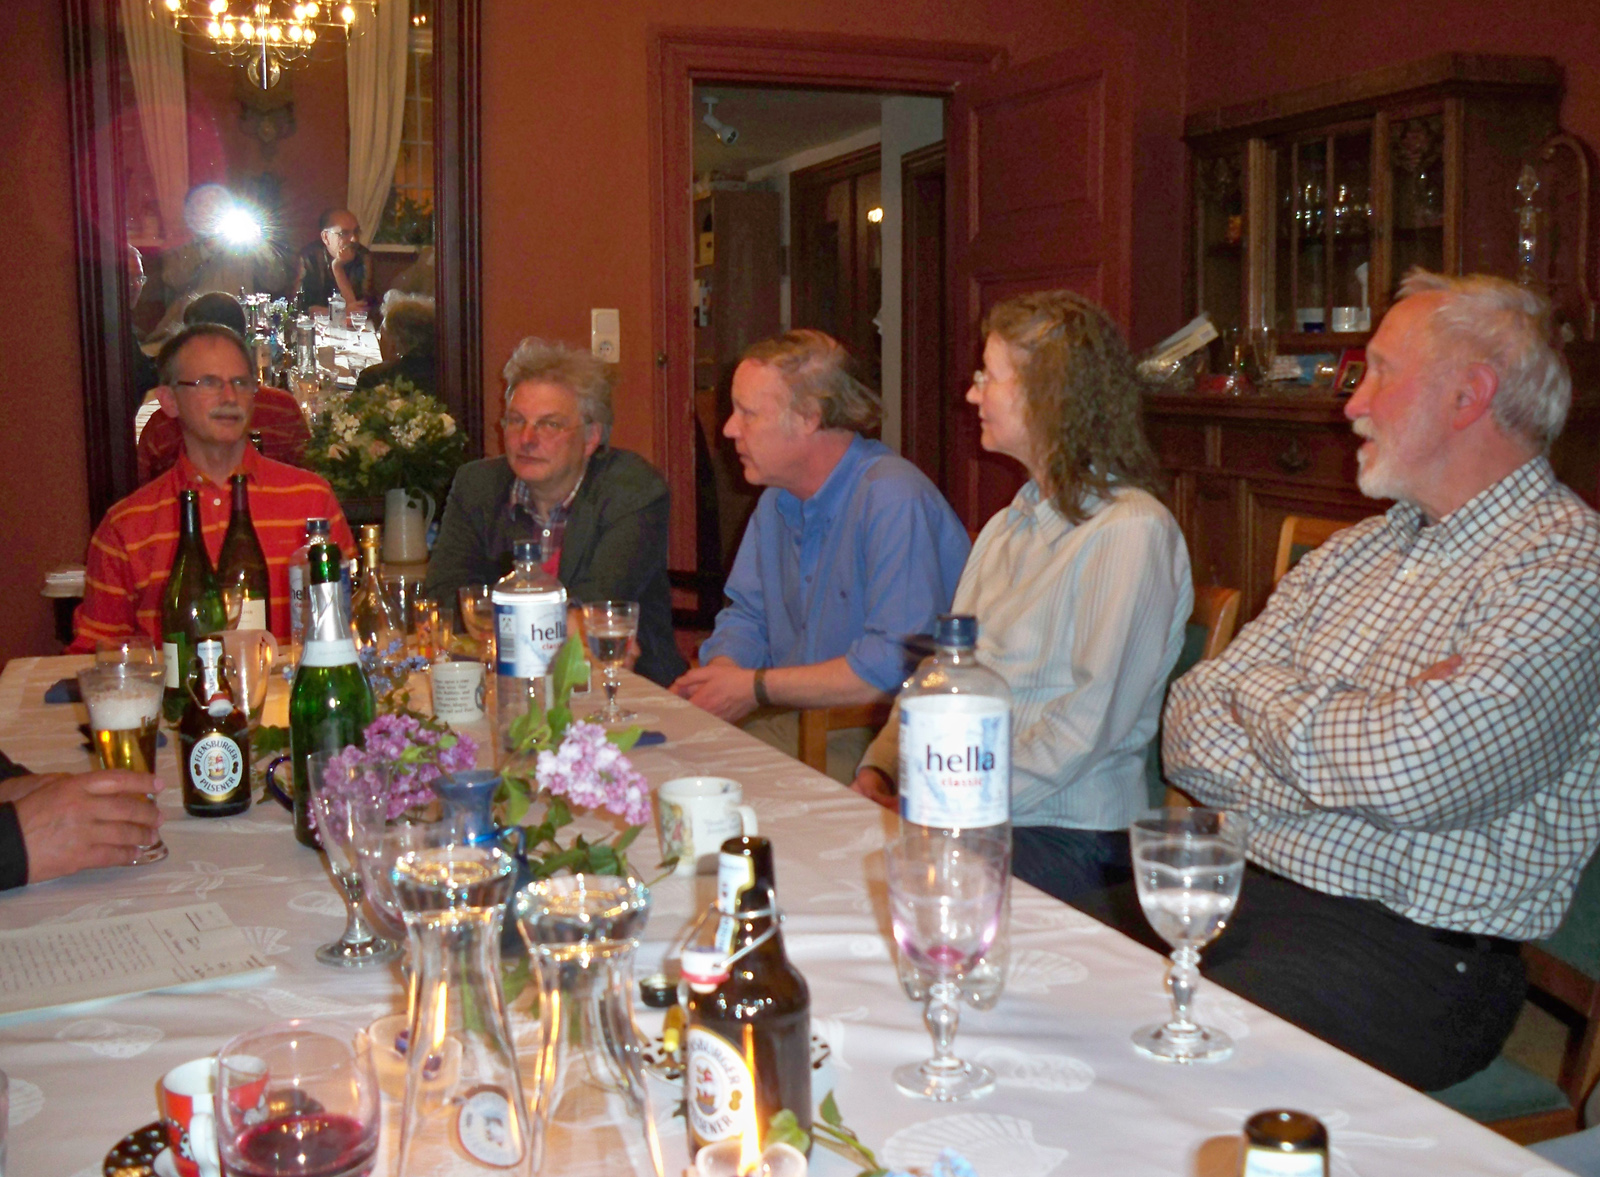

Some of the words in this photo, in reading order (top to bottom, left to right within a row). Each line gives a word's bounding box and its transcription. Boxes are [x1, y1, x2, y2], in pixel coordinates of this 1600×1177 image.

[195, 740, 238, 762] FLENSBURGER
[927, 744, 995, 773] hella
[200, 777, 235, 792] PILSENER
